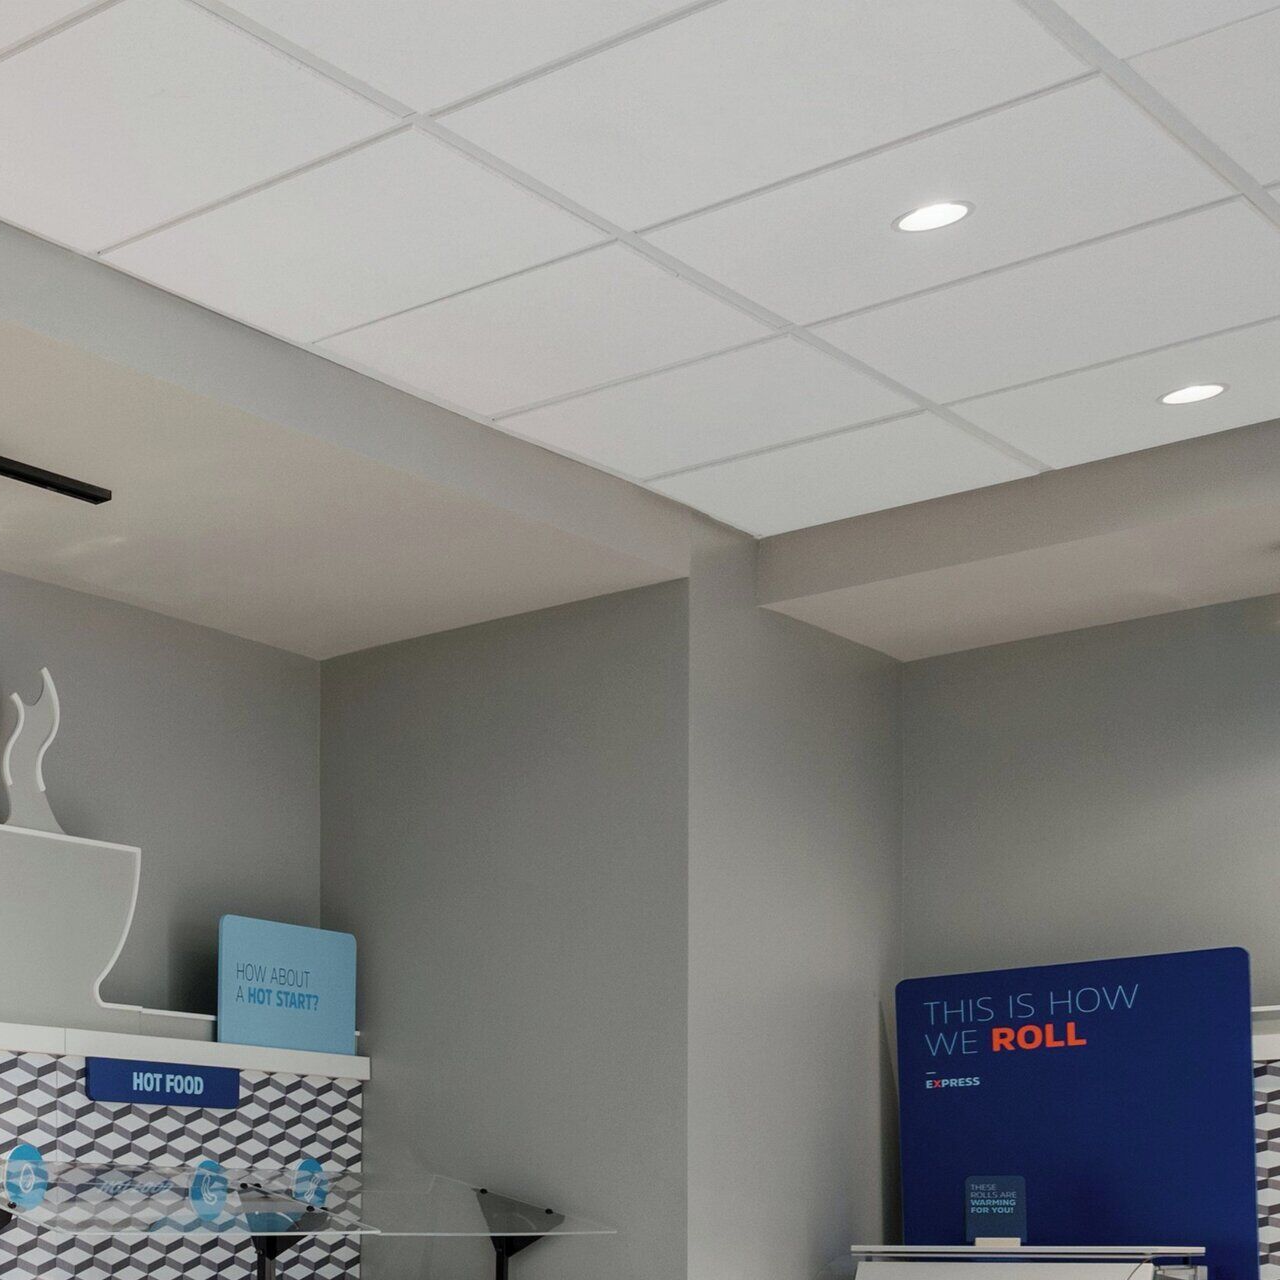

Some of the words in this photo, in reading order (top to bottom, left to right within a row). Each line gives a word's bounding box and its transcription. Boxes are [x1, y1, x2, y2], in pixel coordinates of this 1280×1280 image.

[236, 963, 267, 984] HOW
[269, 967, 311, 989] ABOUT
[235, 985, 245, 1003] A
[247, 986, 273, 1006] HOT
[275, 990, 320, 1012] START?
[923, 996, 995, 1026] THIS
[1007, 993, 1035, 1019] IS
[1049, 984, 1139, 1016] HOW
[924, 1029, 978, 1057] WE
[991, 1021, 1088, 1053] ROLL
[132, 1071, 163, 1092] HOT
[165, 1074, 204, 1095] FOOD
[925, 1076, 981, 1089] EXPRESS
